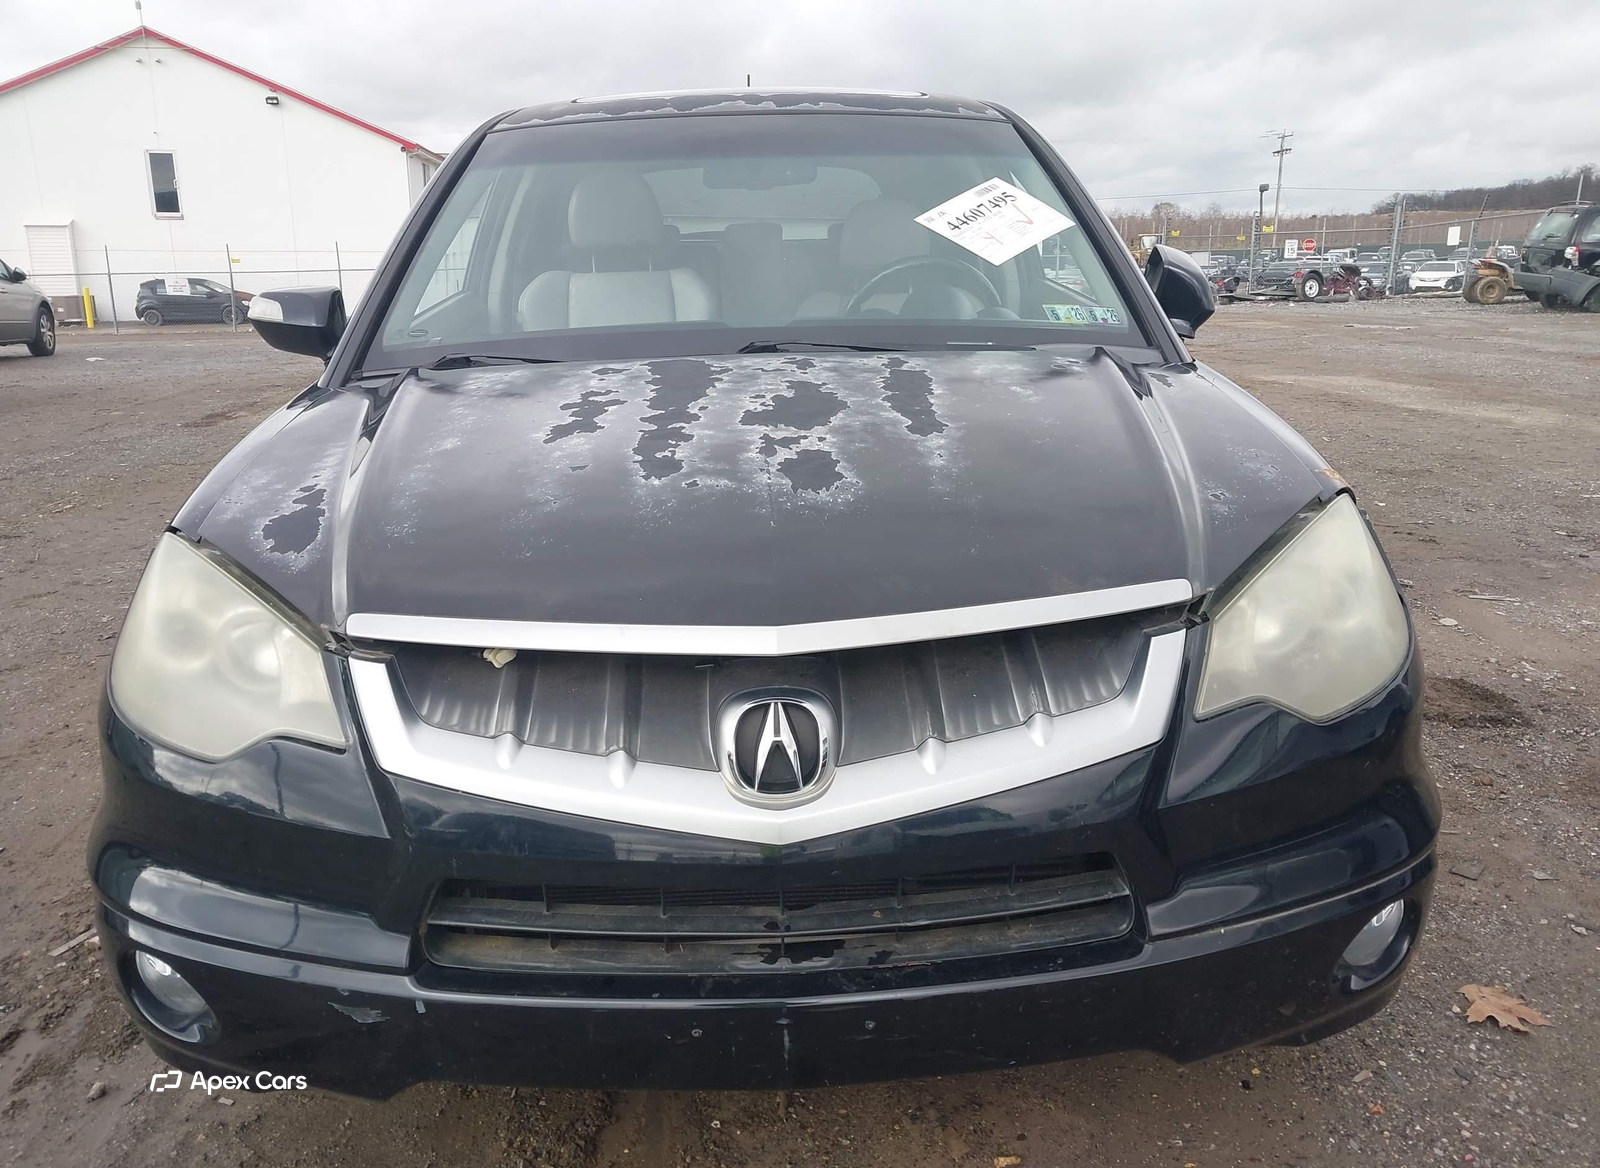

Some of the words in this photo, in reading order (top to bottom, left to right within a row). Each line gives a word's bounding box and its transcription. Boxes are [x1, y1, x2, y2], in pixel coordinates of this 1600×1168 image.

[946, 192, 1018, 232] 44607495
[1071, 307, 1086, 321] 26
[1106, 309, 1121, 322] 26
